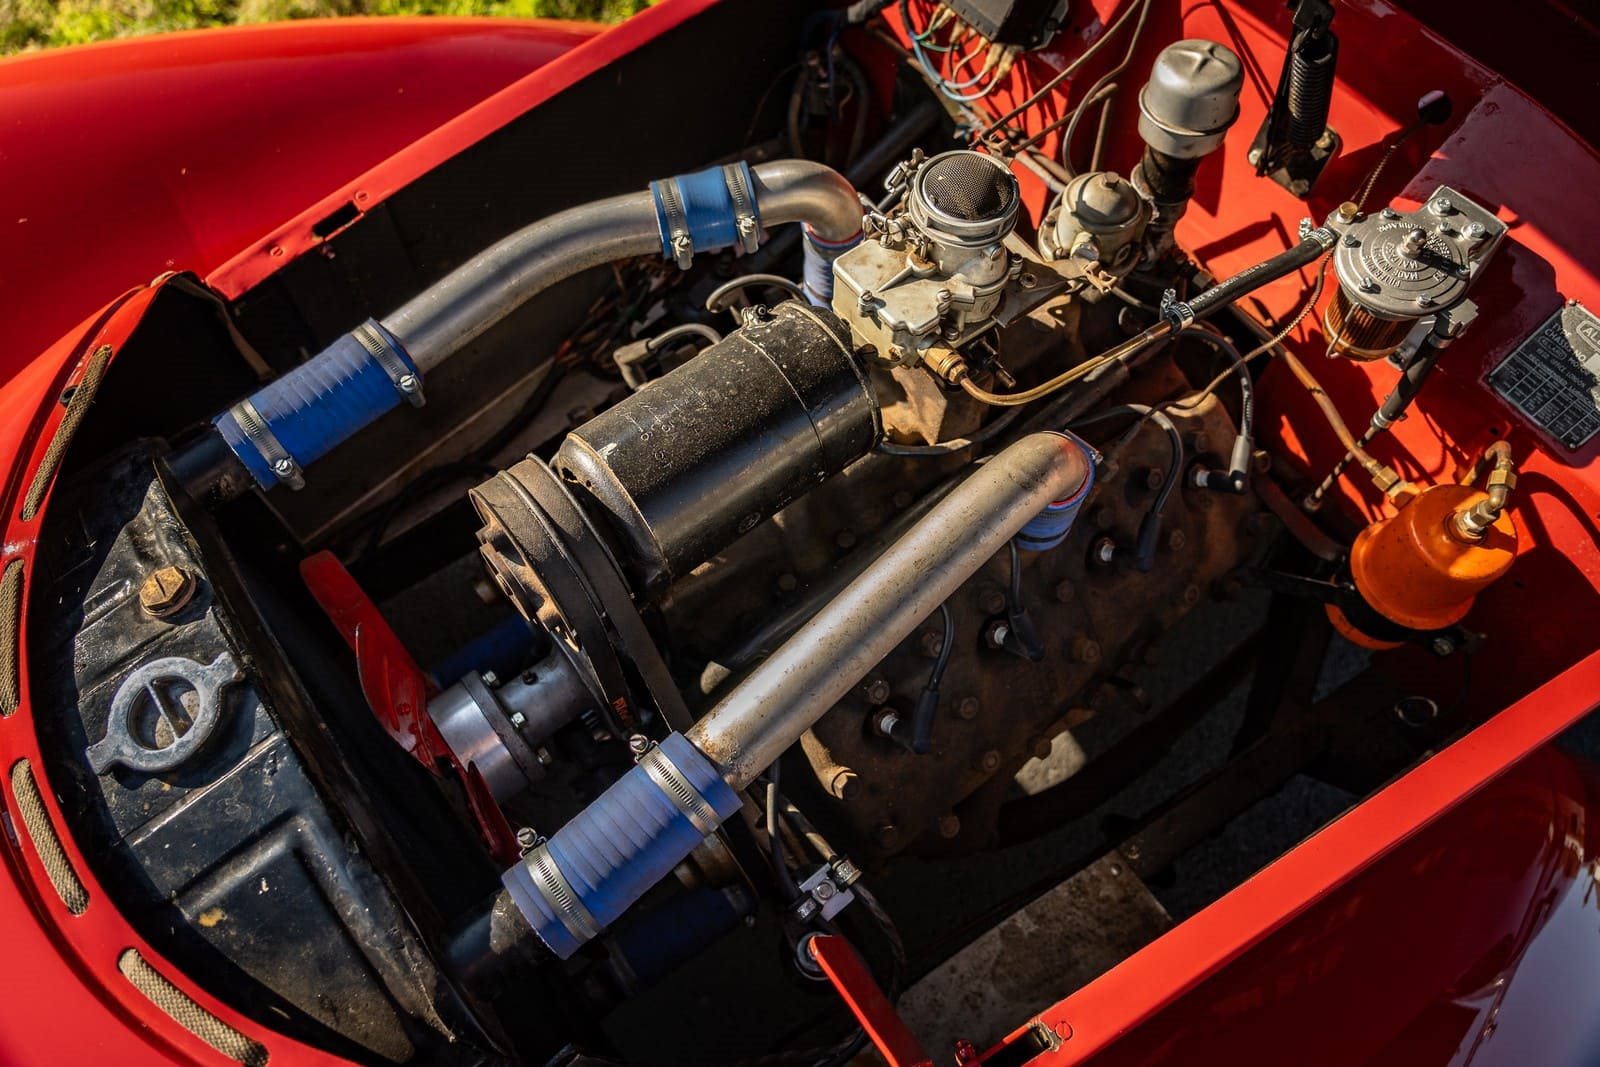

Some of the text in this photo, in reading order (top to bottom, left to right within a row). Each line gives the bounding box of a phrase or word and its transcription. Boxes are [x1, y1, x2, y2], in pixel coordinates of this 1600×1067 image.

[1393, 268, 1418, 280] MADE
[1552, 323, 1572, 338] TYPE
[1545, 328, 1575, 352] CHASSIS
